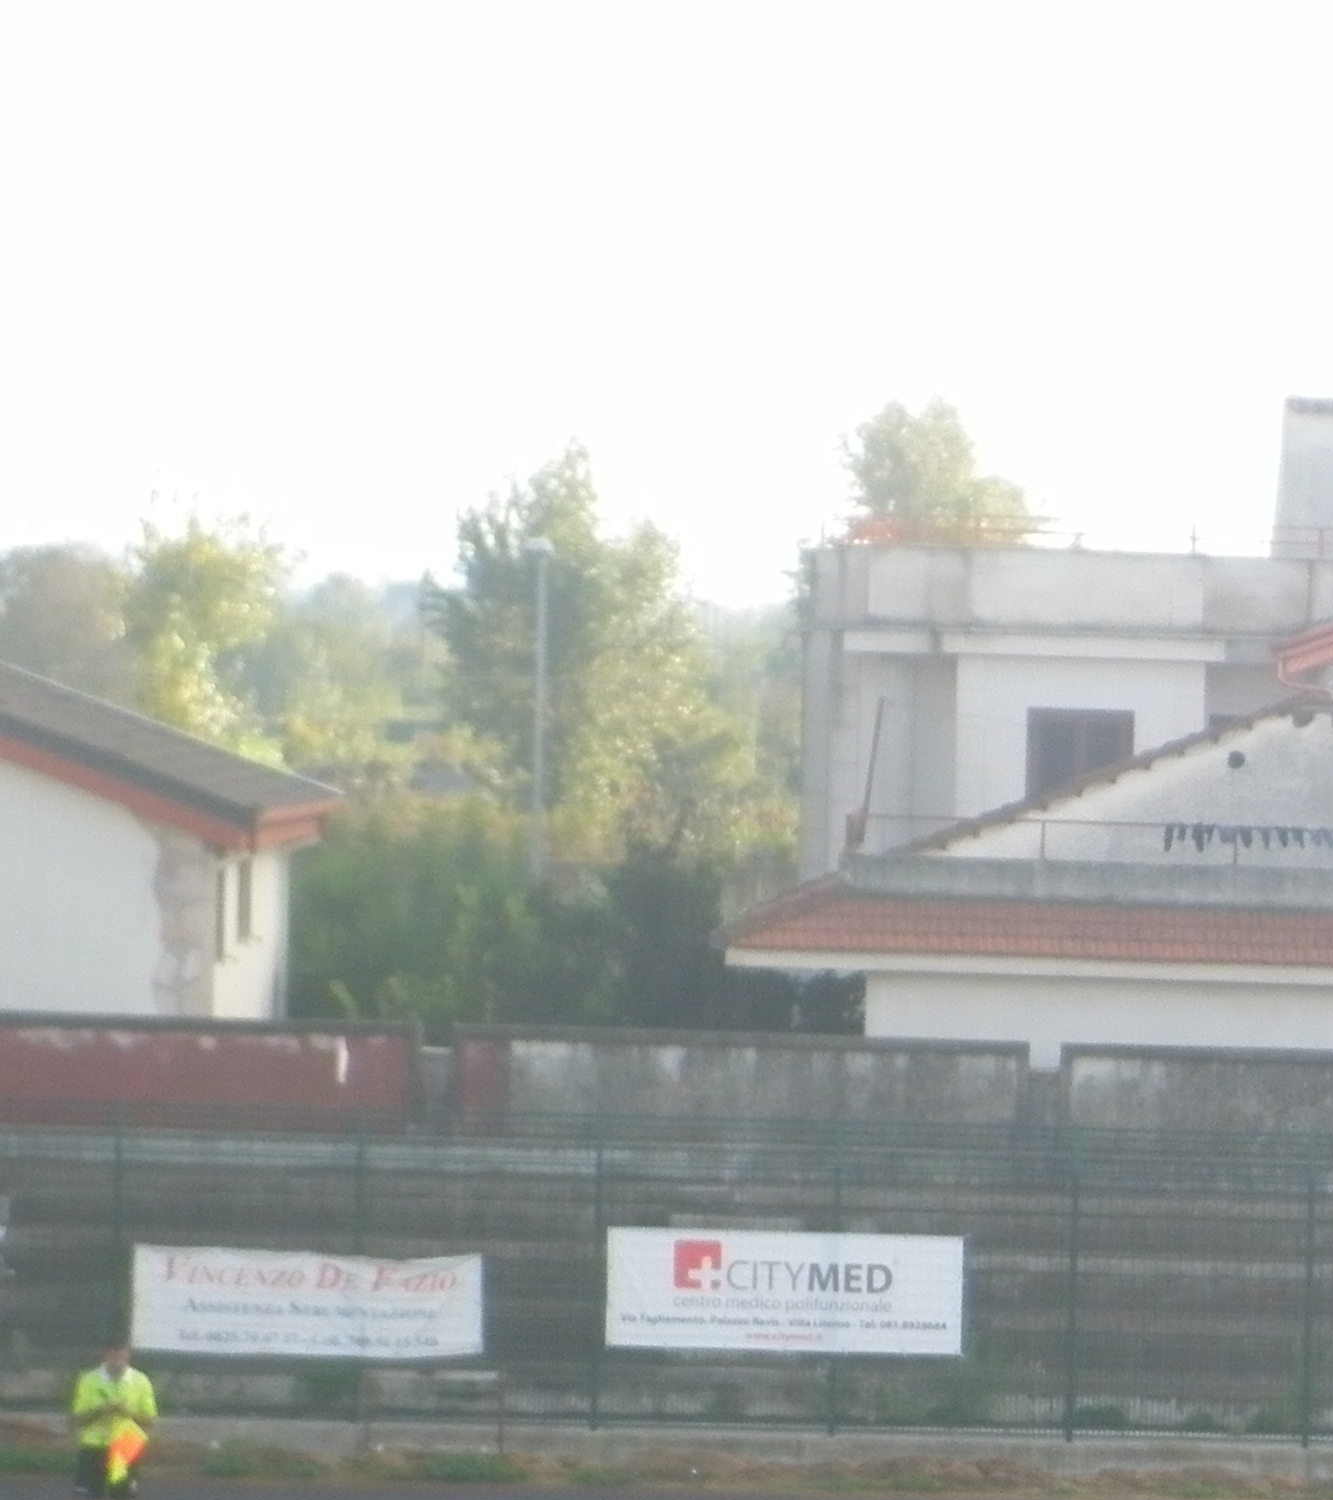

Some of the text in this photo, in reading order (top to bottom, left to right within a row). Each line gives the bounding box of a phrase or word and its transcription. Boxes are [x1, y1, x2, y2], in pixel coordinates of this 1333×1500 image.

[726, 1259, 893, 1294] CITYMED
[673, 1296, 892, 1314] centro medico polifunzionale
[621, 1313, 637, 1323] Via
